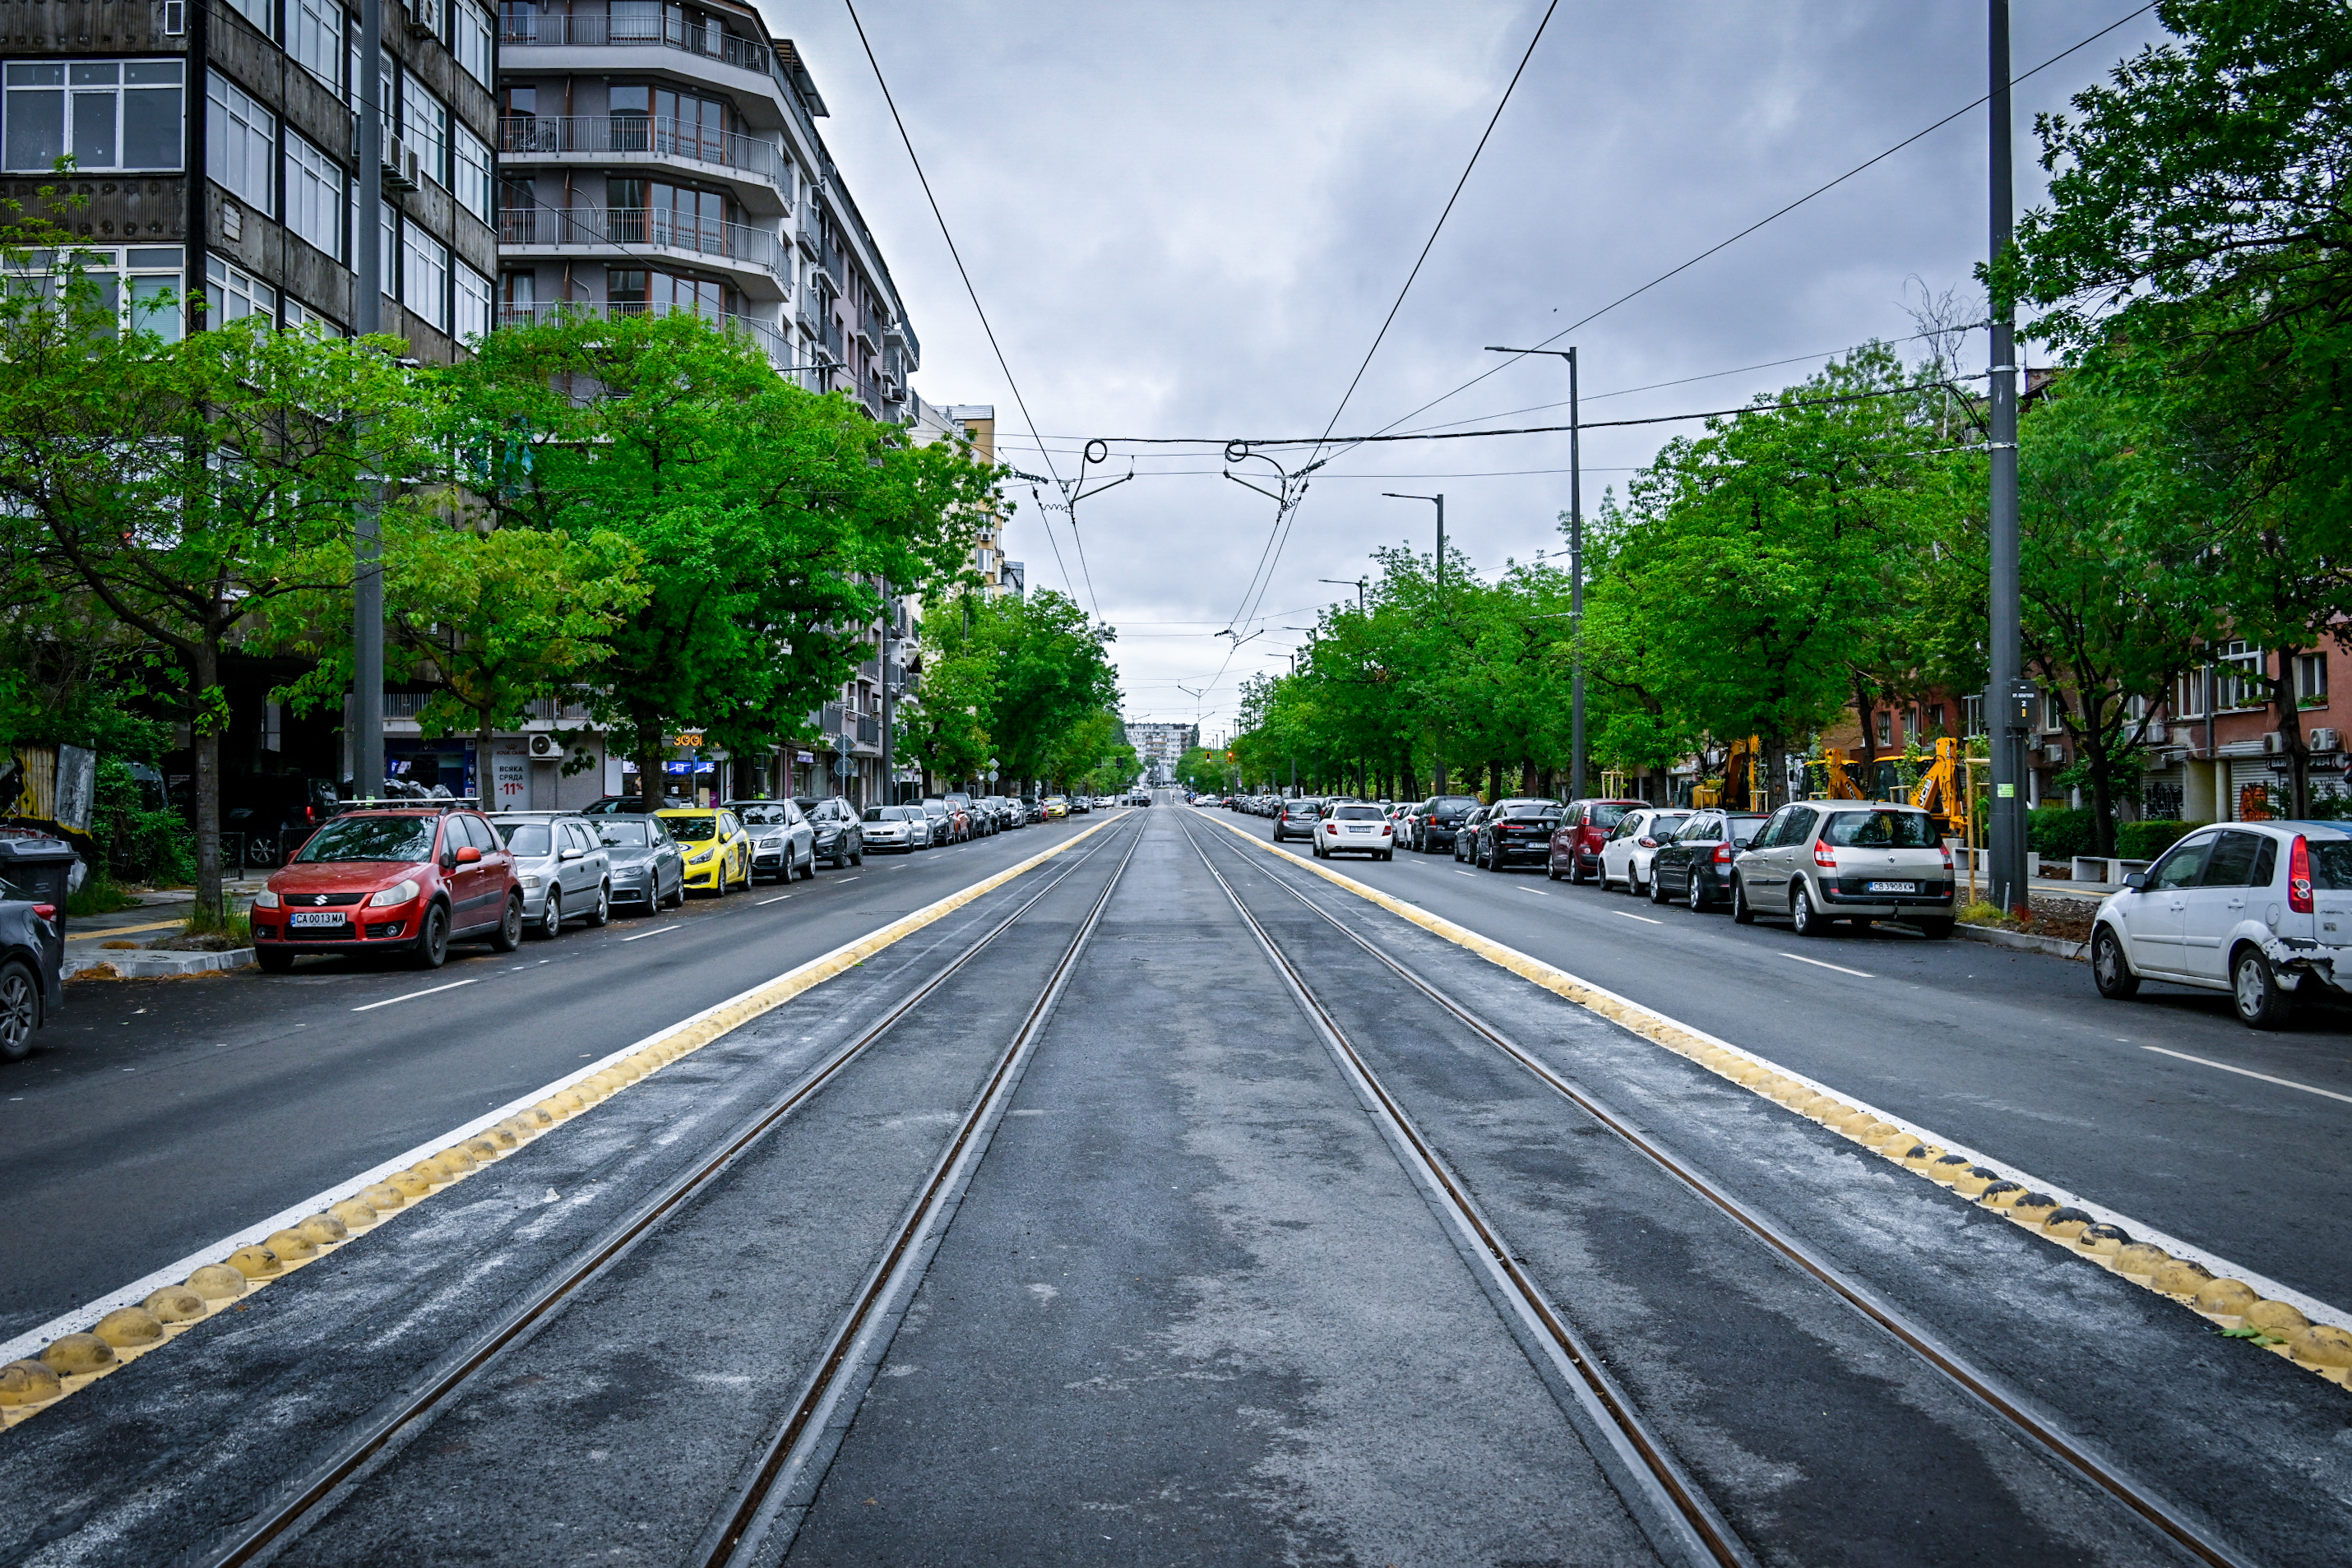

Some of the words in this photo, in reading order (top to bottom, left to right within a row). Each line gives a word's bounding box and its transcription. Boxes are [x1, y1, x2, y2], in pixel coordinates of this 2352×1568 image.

[499, 783, 524, 795] -11%
[1919, 778, 1933, 807] JCB
[1873, 882, 1884, 890] CB
[1884, 882, 1903, 890] 3908
[296, 914, 308, 923] CA
[309, 914, 331, 923] 0013
[331, 914, 344, 923] MA
